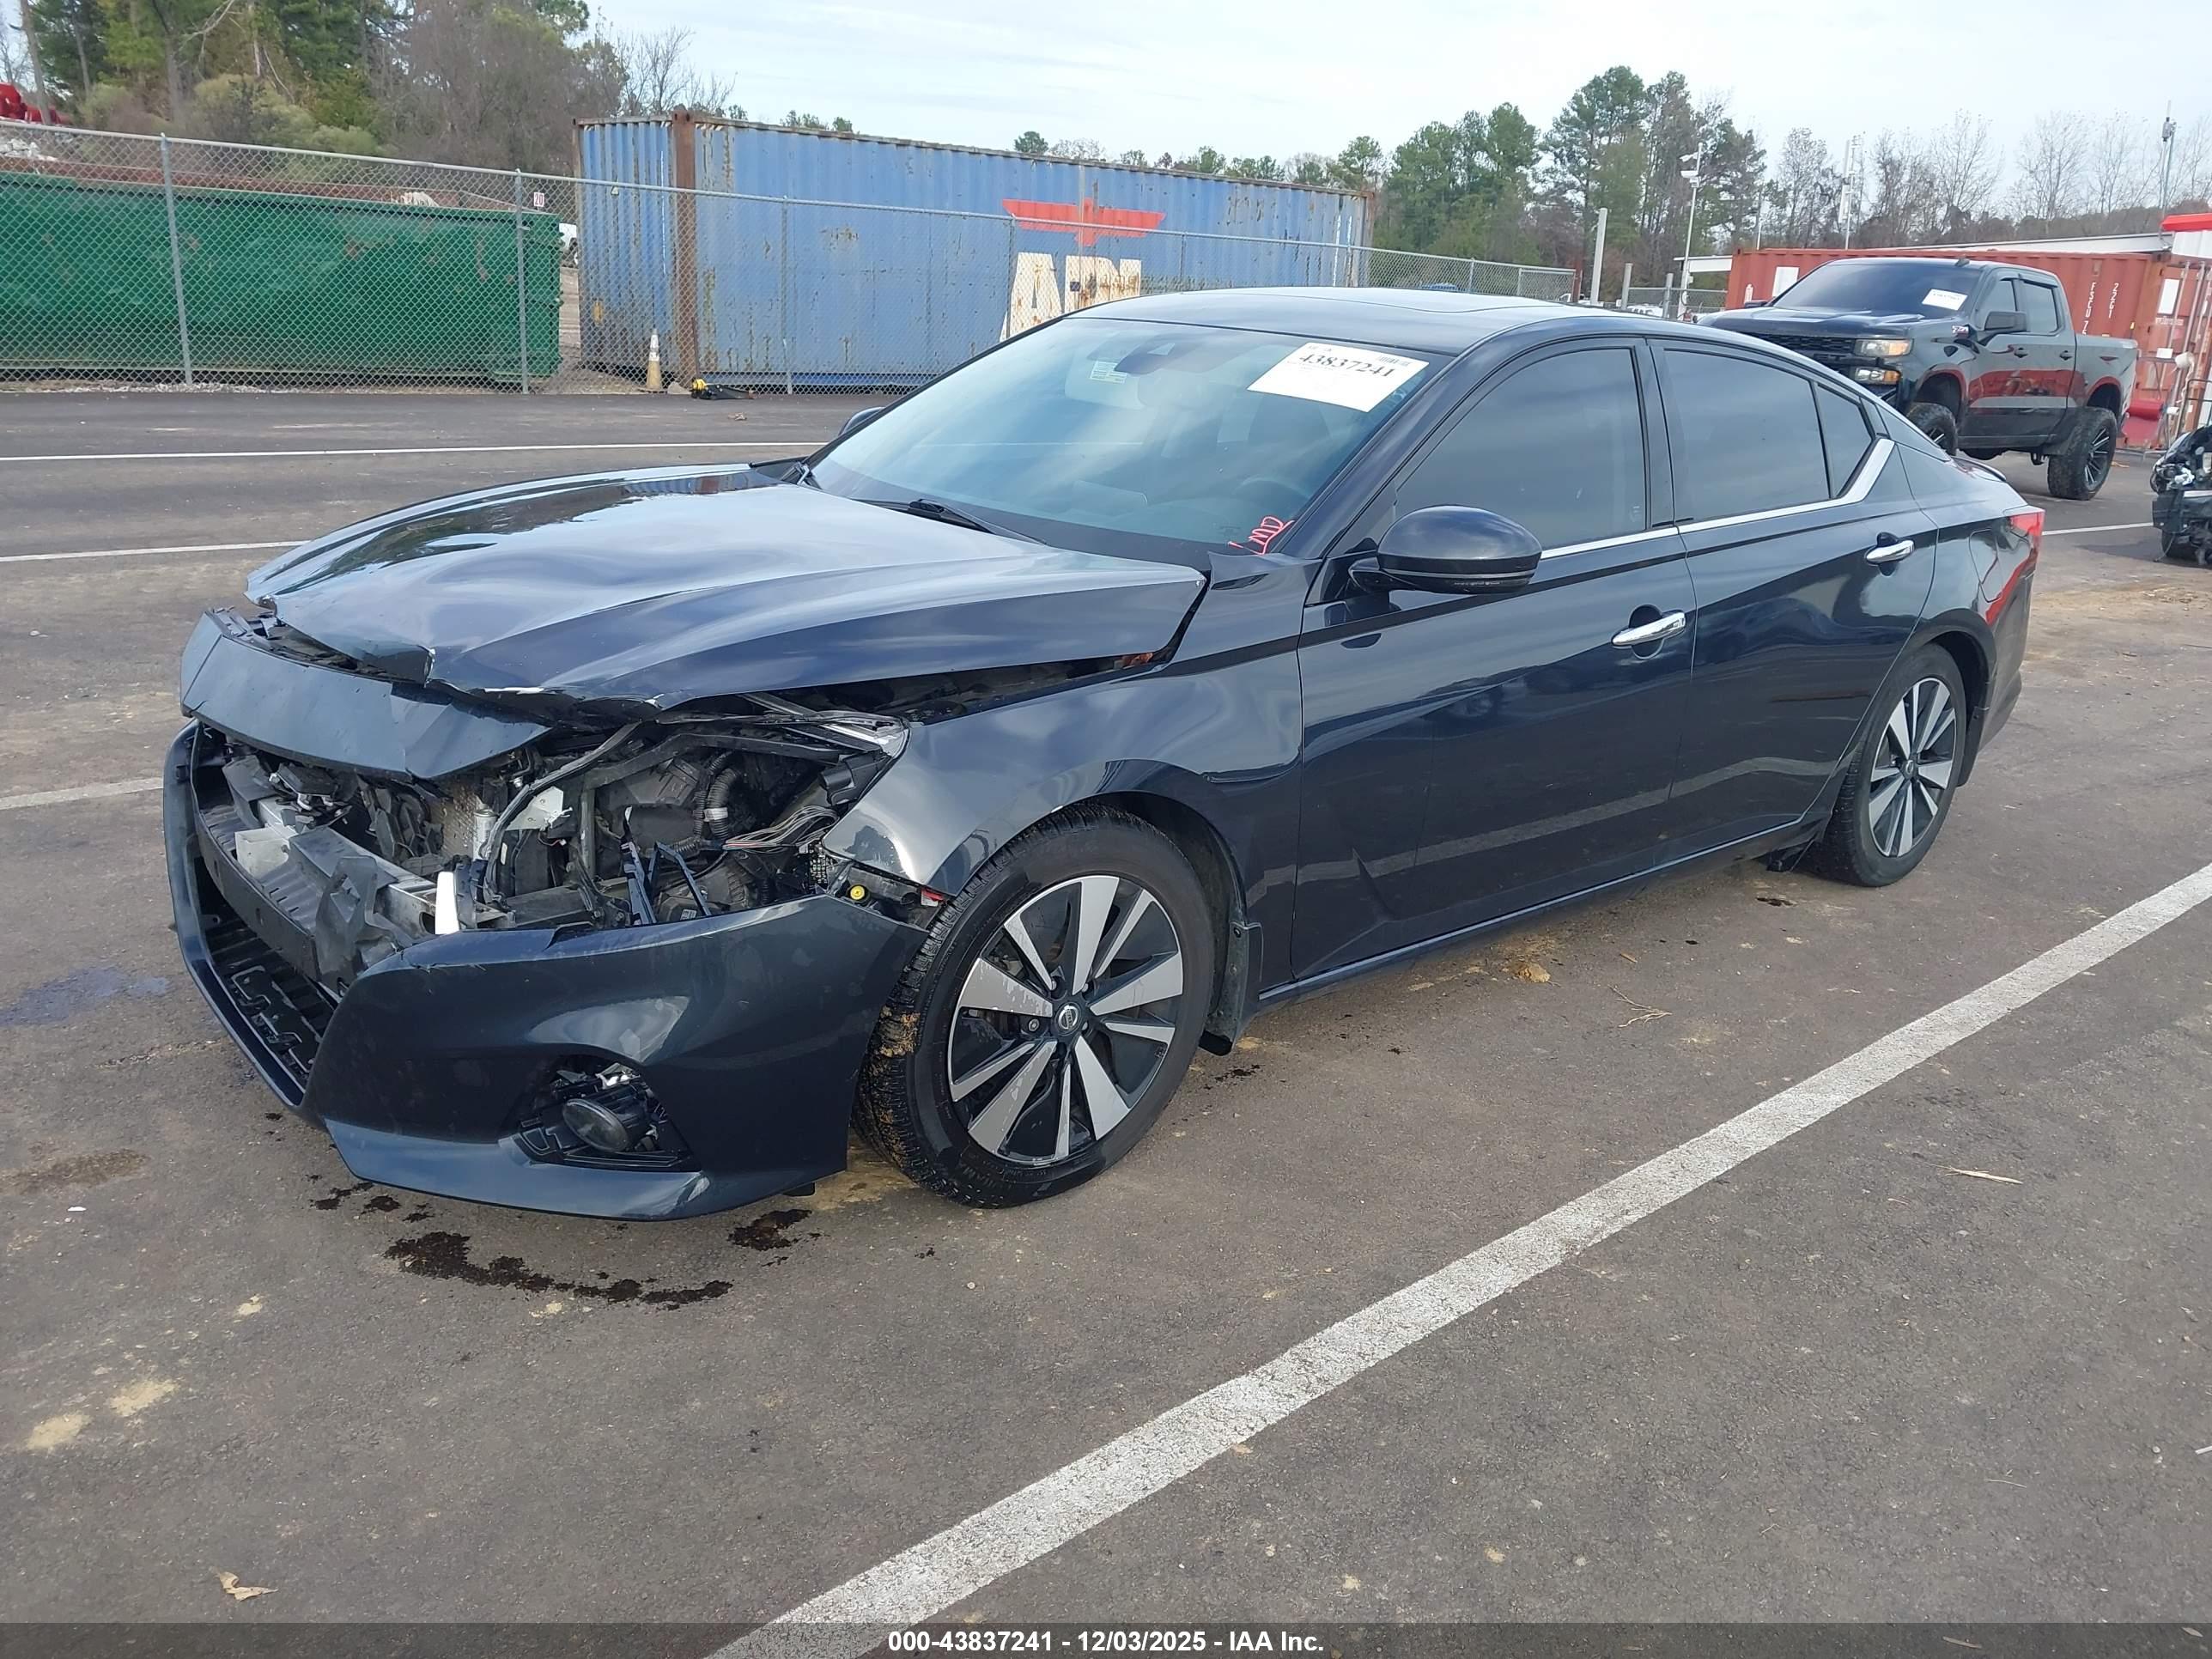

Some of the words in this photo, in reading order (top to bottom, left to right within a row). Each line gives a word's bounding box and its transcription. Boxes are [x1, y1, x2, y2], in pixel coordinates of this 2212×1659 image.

[534, 193, 544, 206] 20
[2085, 282, 2097, 319] FSCU
[2108, 282, 2119, 319] 22G1
[1298, 352, 1395, 378] 43837241
